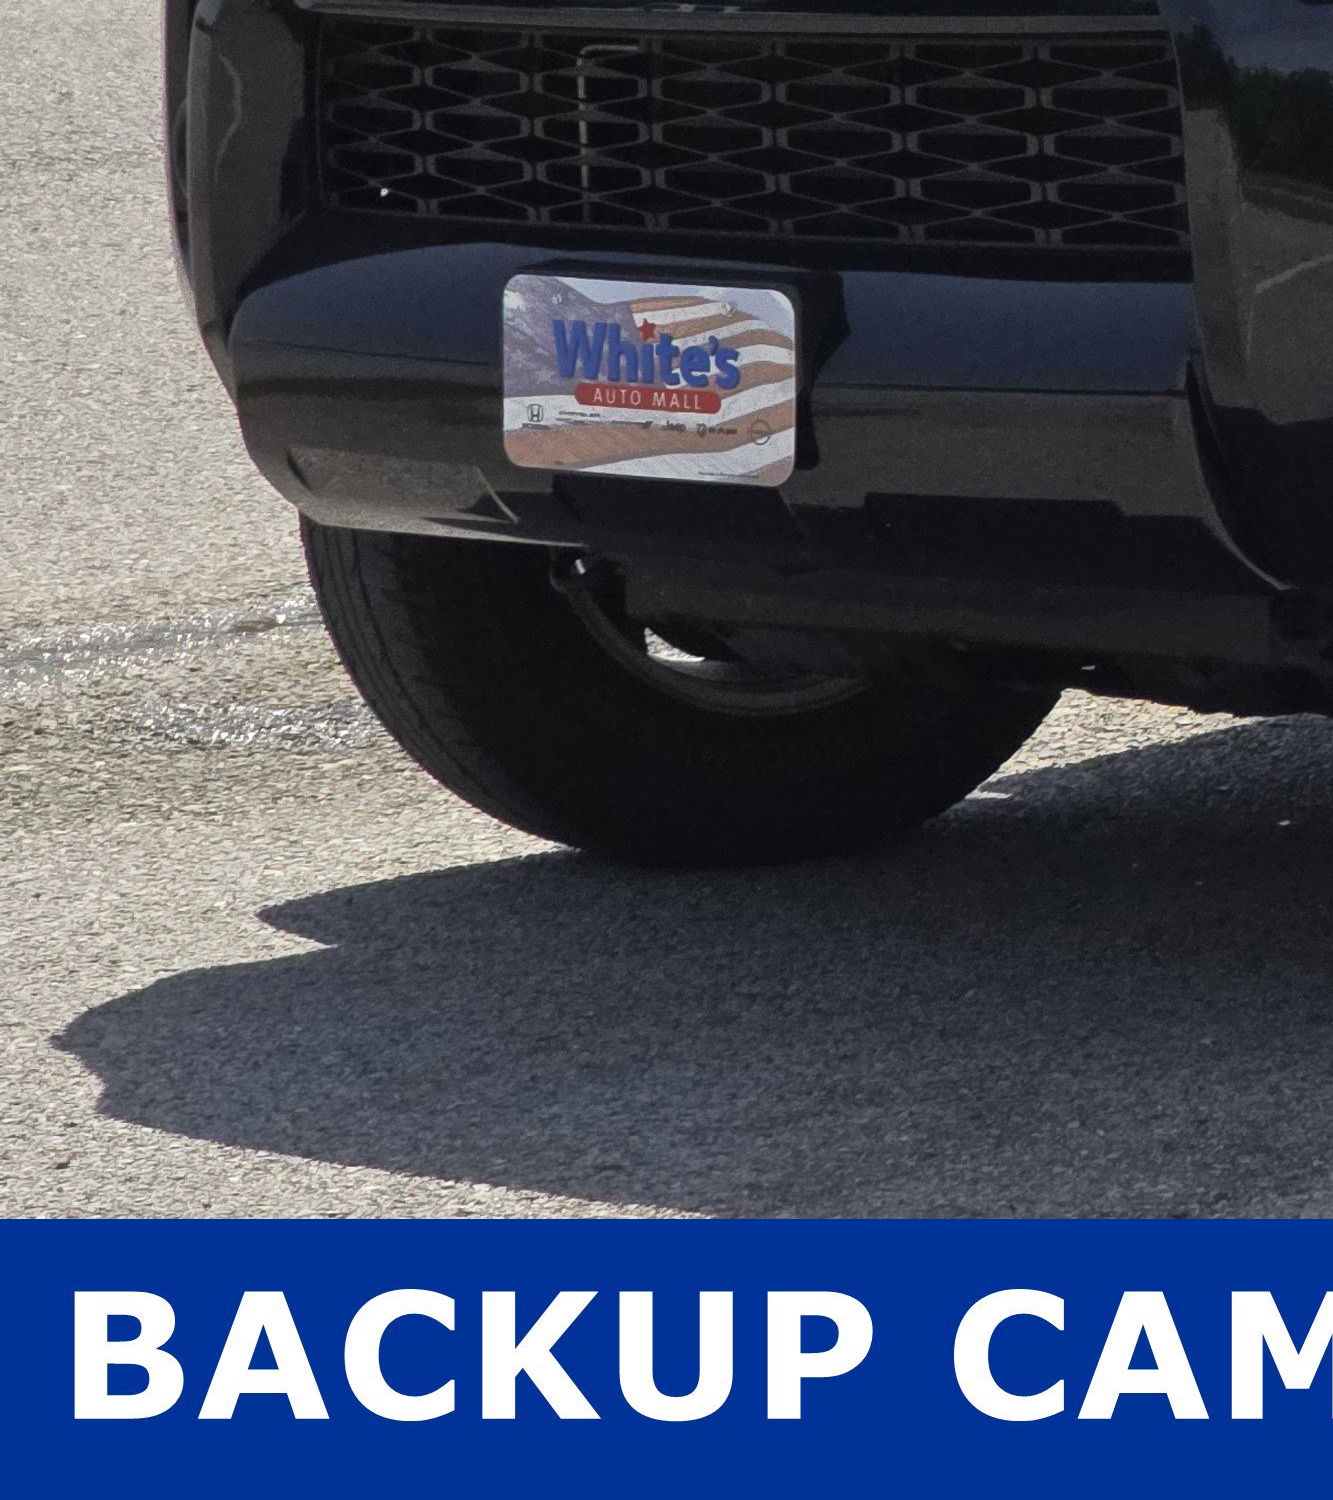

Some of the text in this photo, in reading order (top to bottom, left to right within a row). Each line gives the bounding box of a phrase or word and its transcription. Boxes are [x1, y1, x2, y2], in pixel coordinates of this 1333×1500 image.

[552, 318, 741, 390] White's
[592, 387, 702, 411] AUTO MALL
